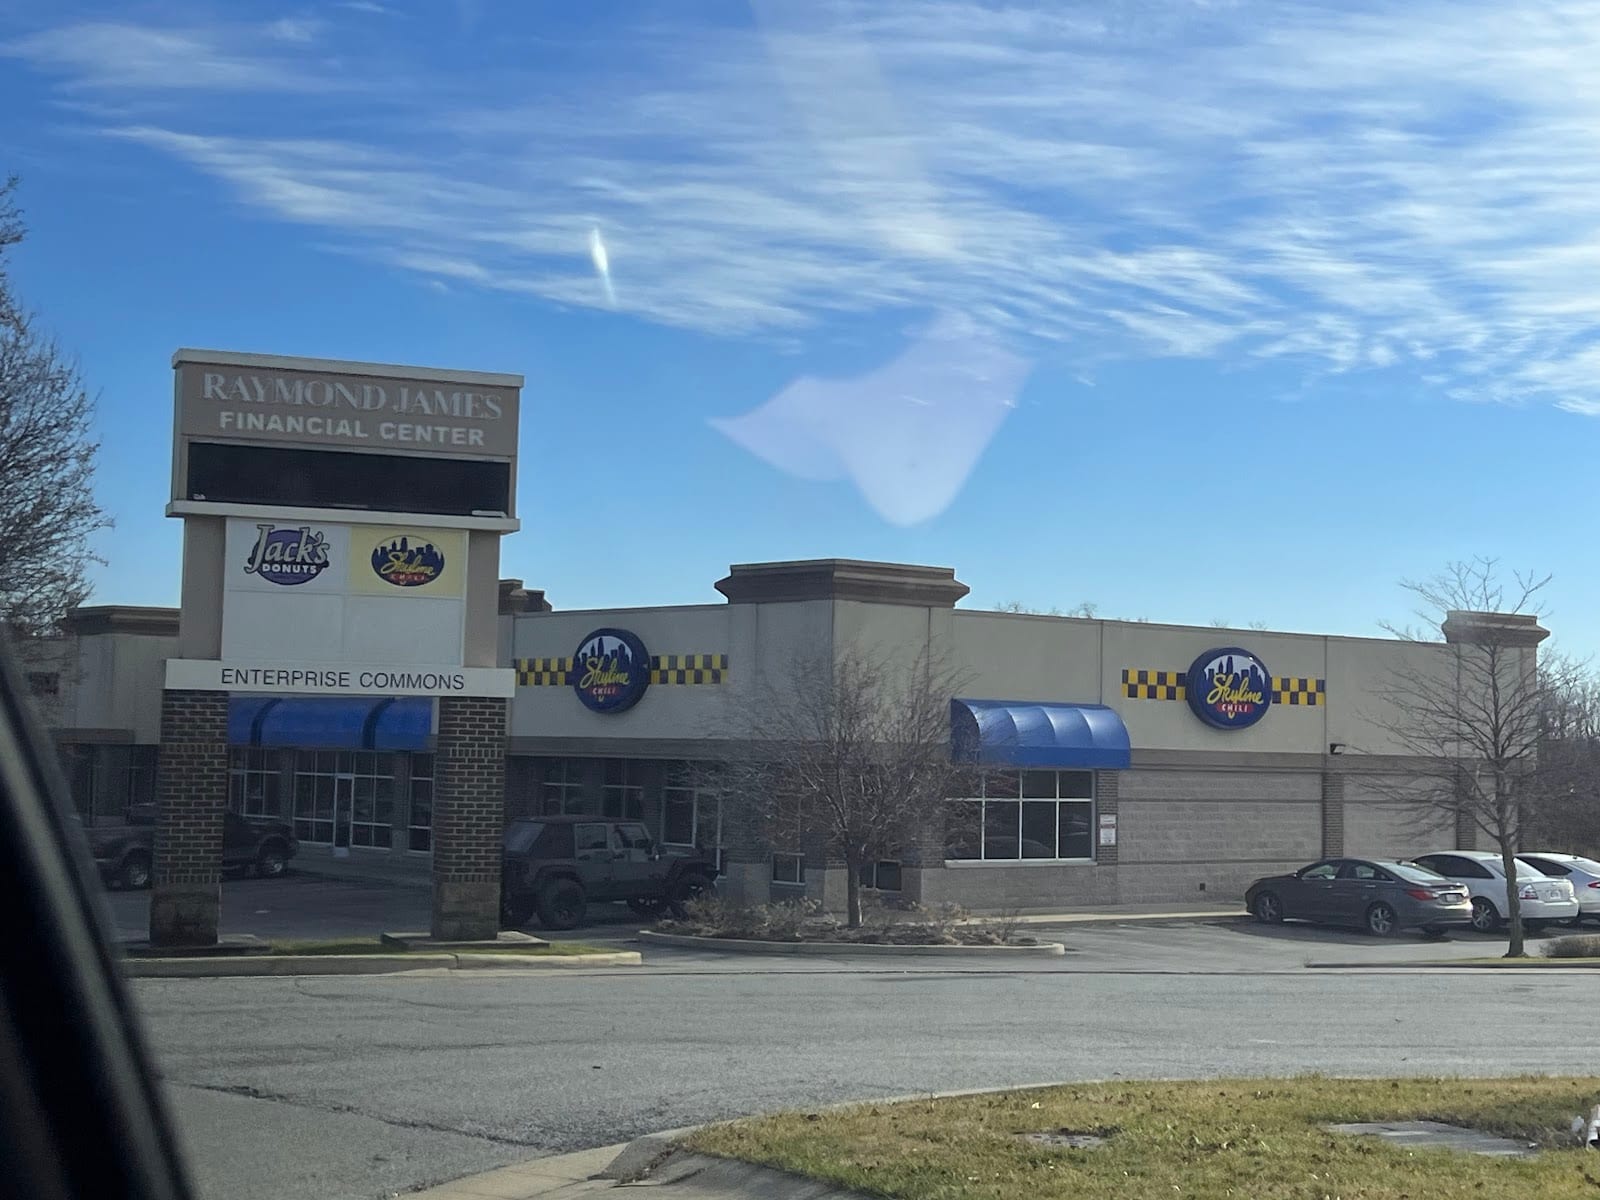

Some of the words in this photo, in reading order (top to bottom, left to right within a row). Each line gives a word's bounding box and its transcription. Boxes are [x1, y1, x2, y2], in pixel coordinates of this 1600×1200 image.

[203, 373, 387, 410] RAYMOND
[393, 386, 504, 420] JAMES
[219, 411, 369, 439] FINANCIAL
[379, 422, 485, 446] CENTER
[244, 524, 330, 574] Jack's
[262, 563, 318, 575] DONUTS
[221, 668, 351, 688] ENTERPRISE
[359, 672, 466, 690] COMMONS
[580, 656, 630, 702] Skyline
[1206, 674, 1264, 719] Skyline
[1221, 703, 1248, 712] CHILI
